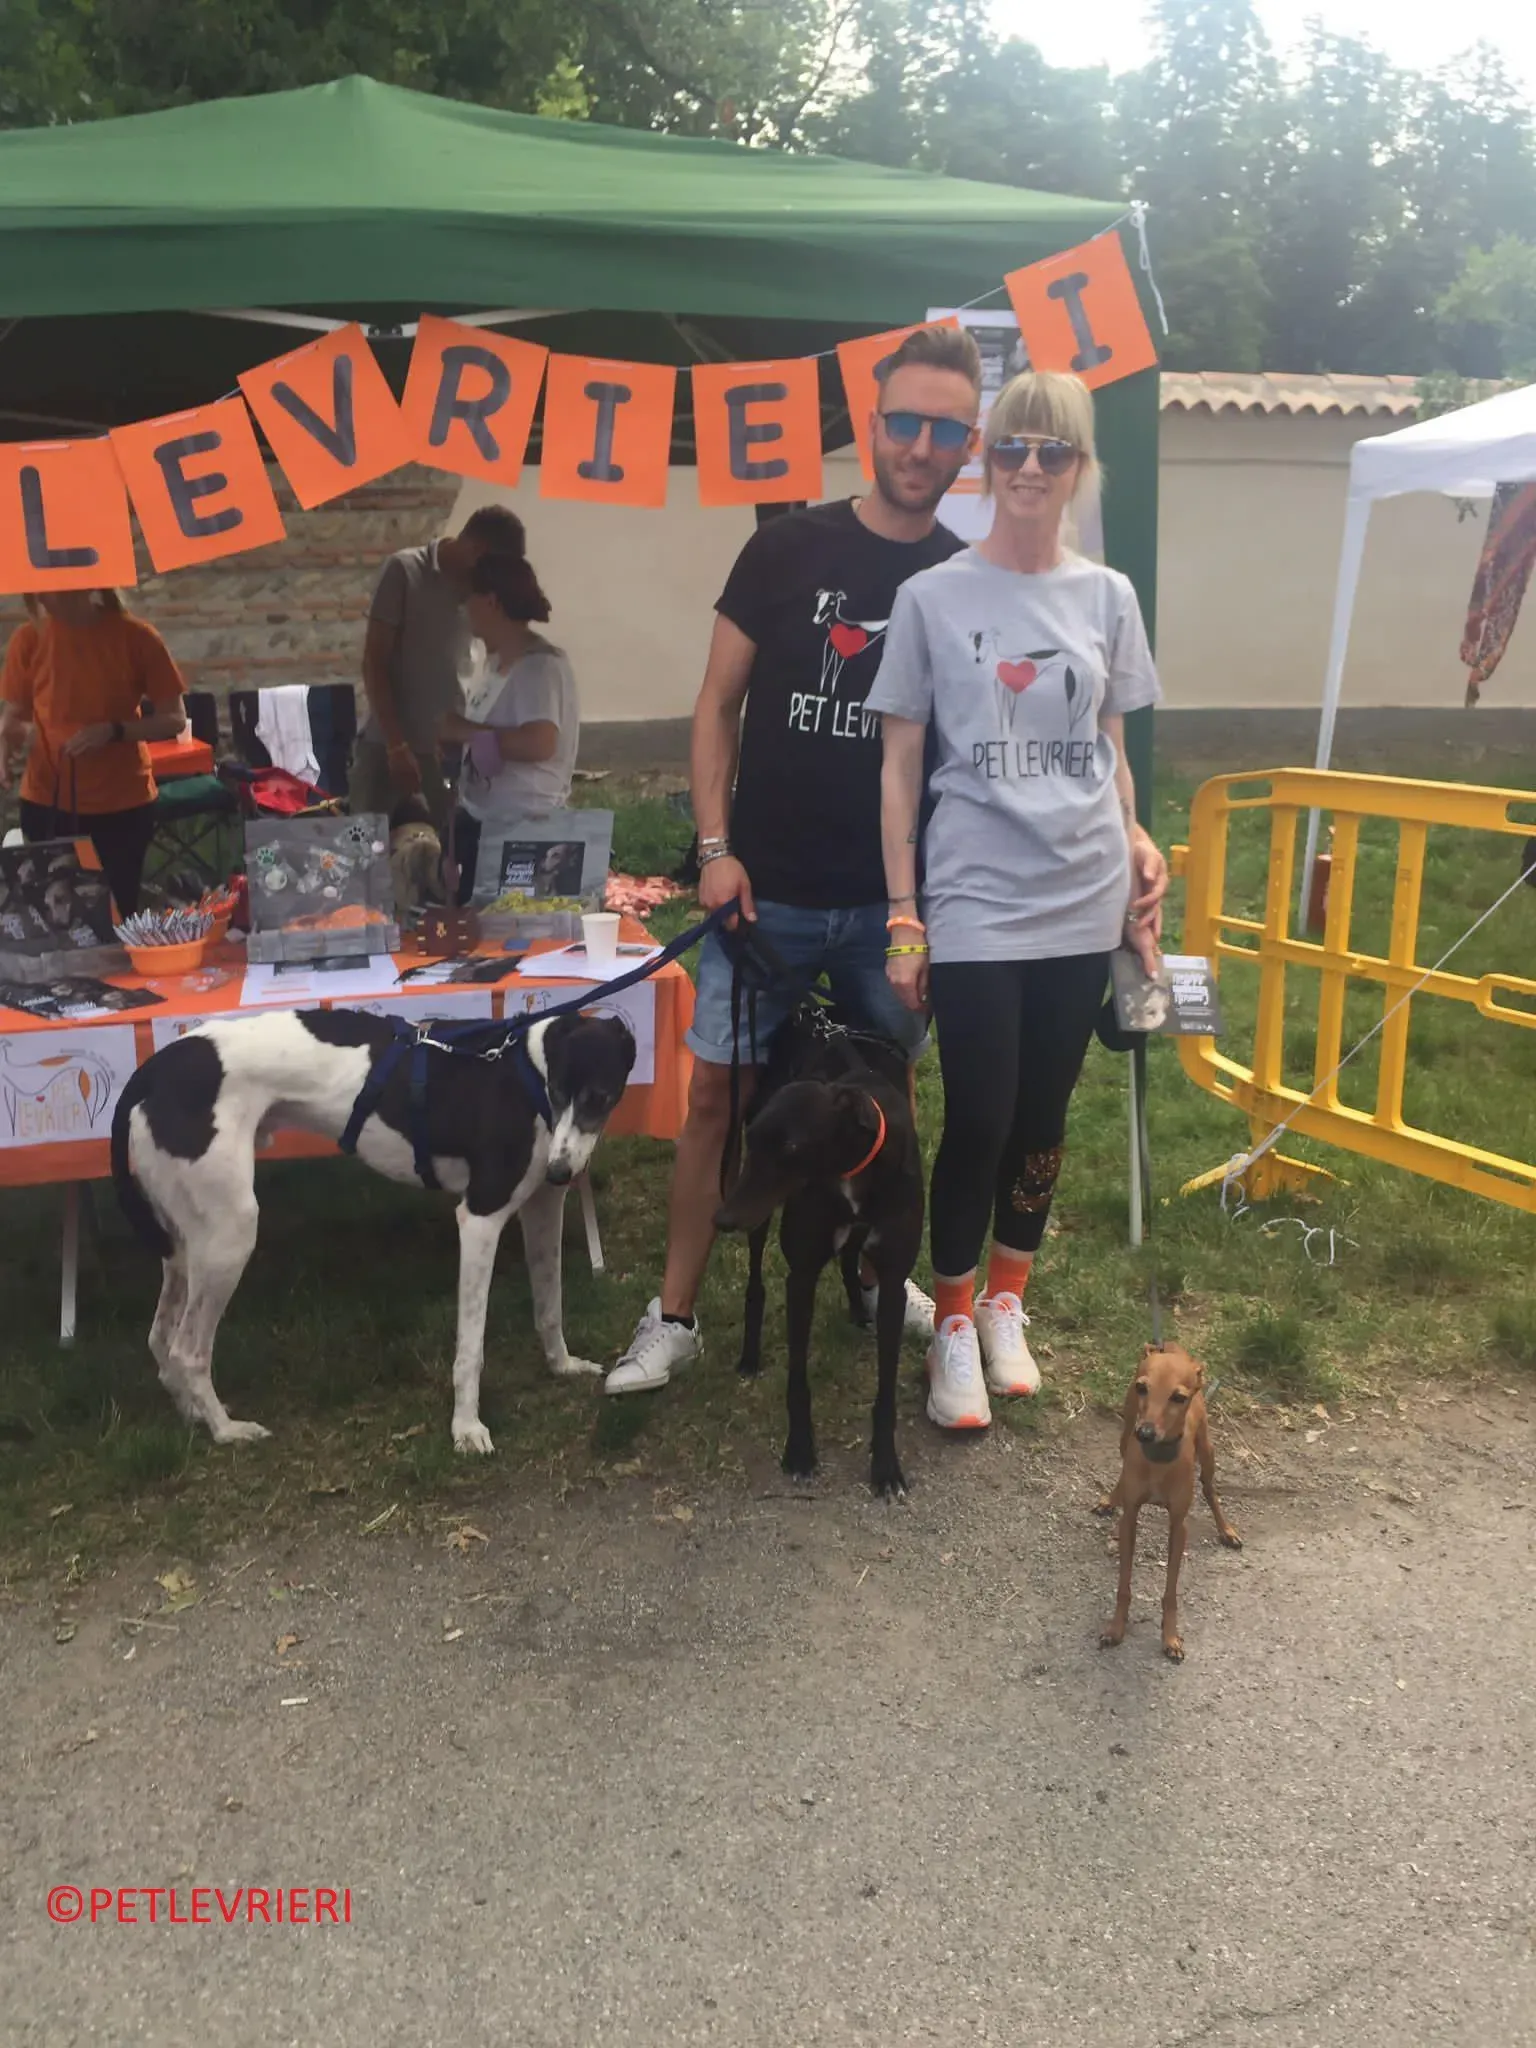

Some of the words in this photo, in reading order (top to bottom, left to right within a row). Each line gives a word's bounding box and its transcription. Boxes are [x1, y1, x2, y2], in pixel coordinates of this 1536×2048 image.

[19, 270, 1114, 569] LEVRIEI
[788, 692, 828, 733] PET
[973, 740, 1008, 779] PET
